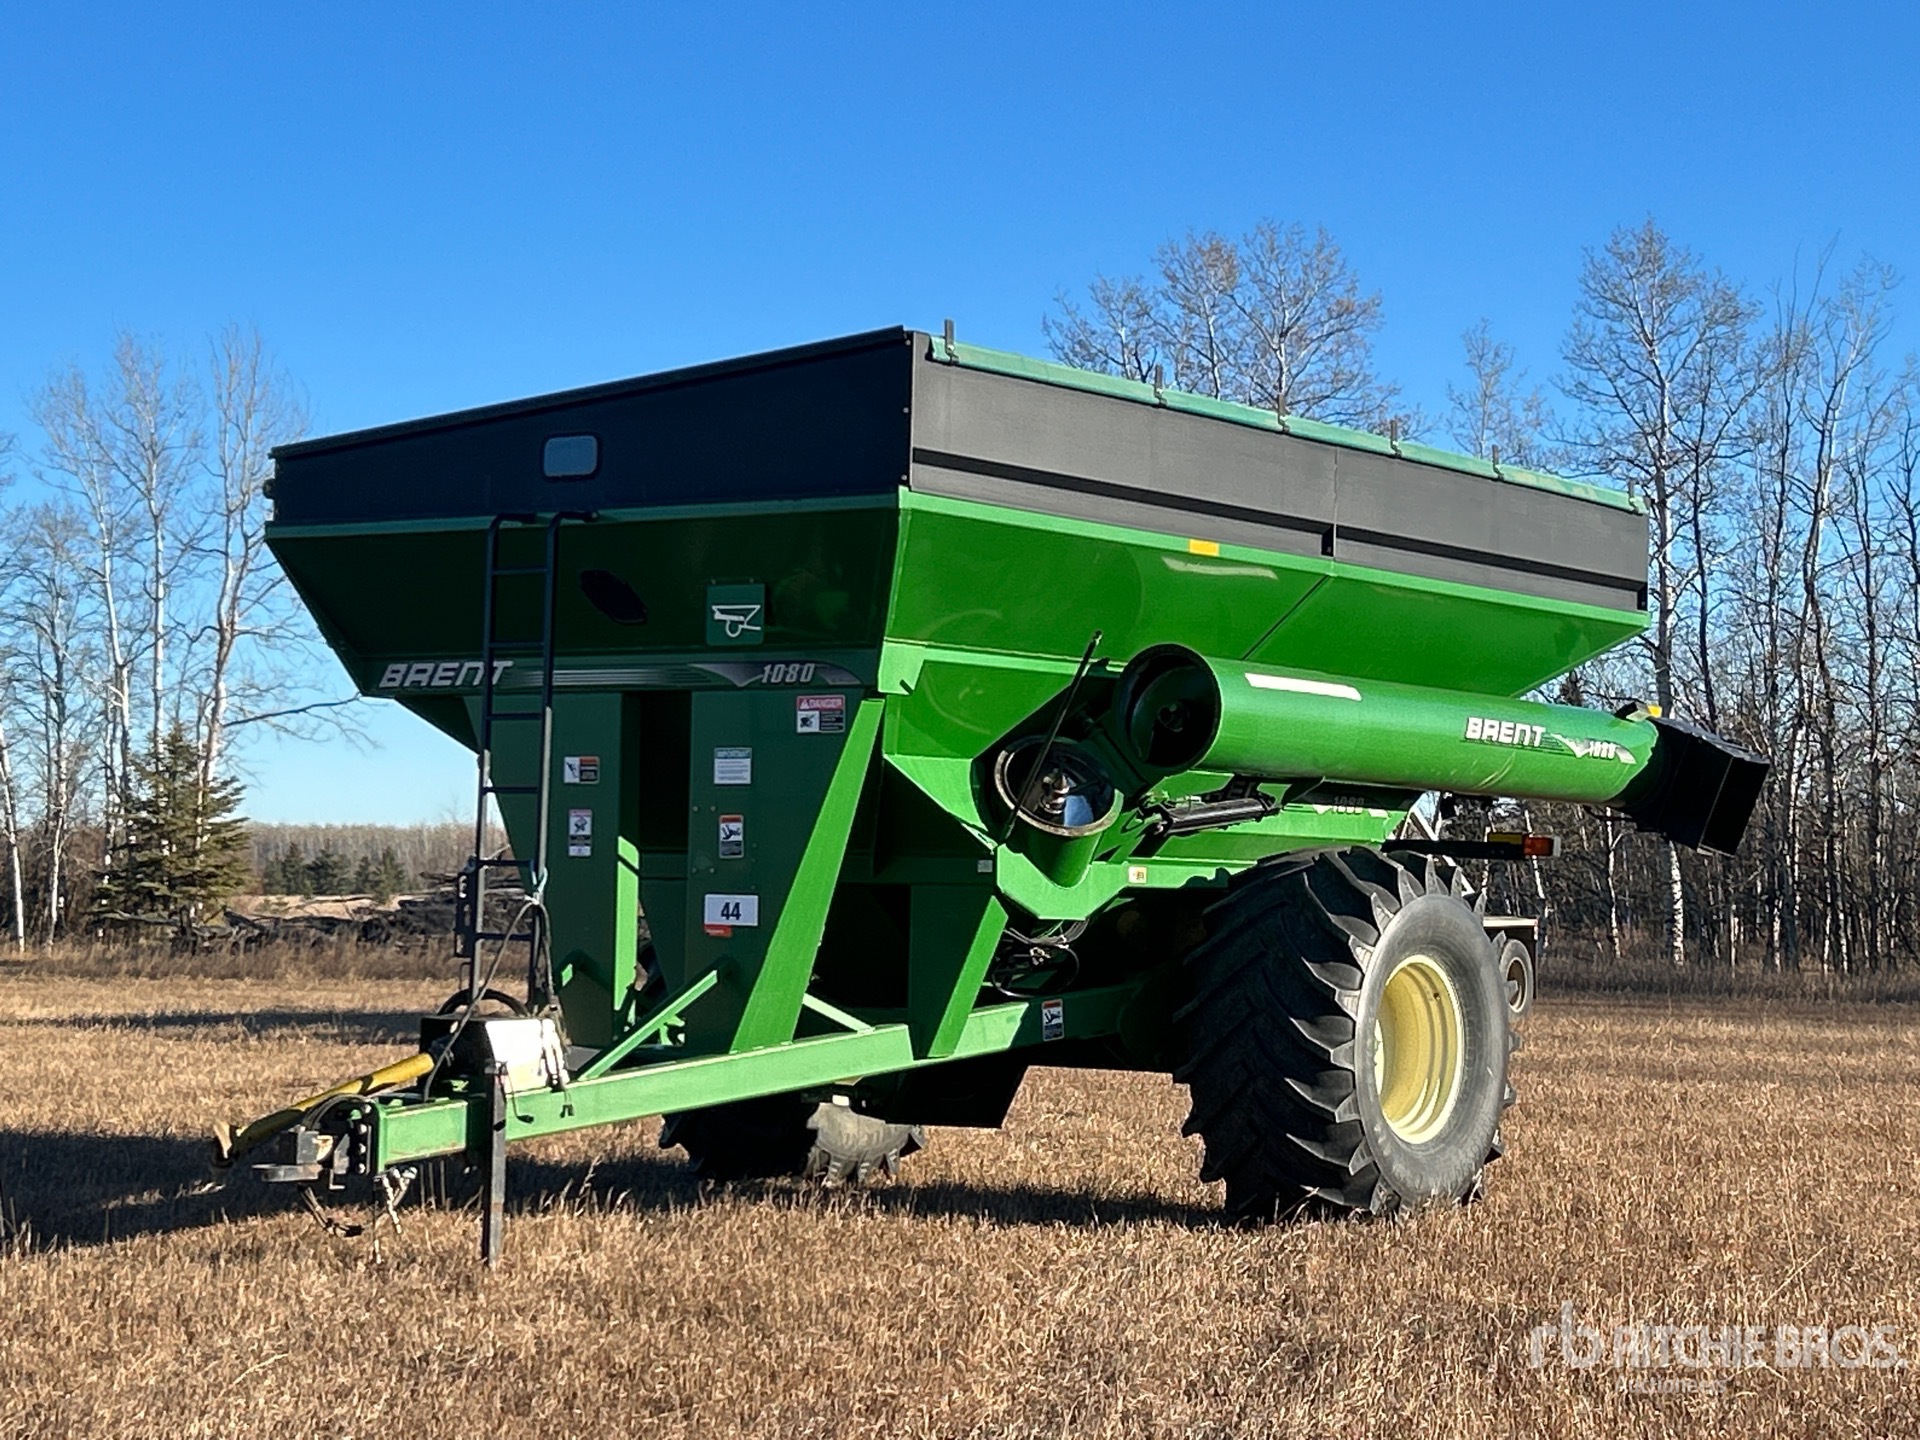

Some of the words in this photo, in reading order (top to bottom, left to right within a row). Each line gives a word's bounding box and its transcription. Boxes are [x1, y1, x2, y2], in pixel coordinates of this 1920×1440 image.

[379, 660, 514, 688] BRENT
[761, 662, 815, 684] 1080
[1465, 716, 1546, 748] BRENT
[720, 901, 742, 921] 44
